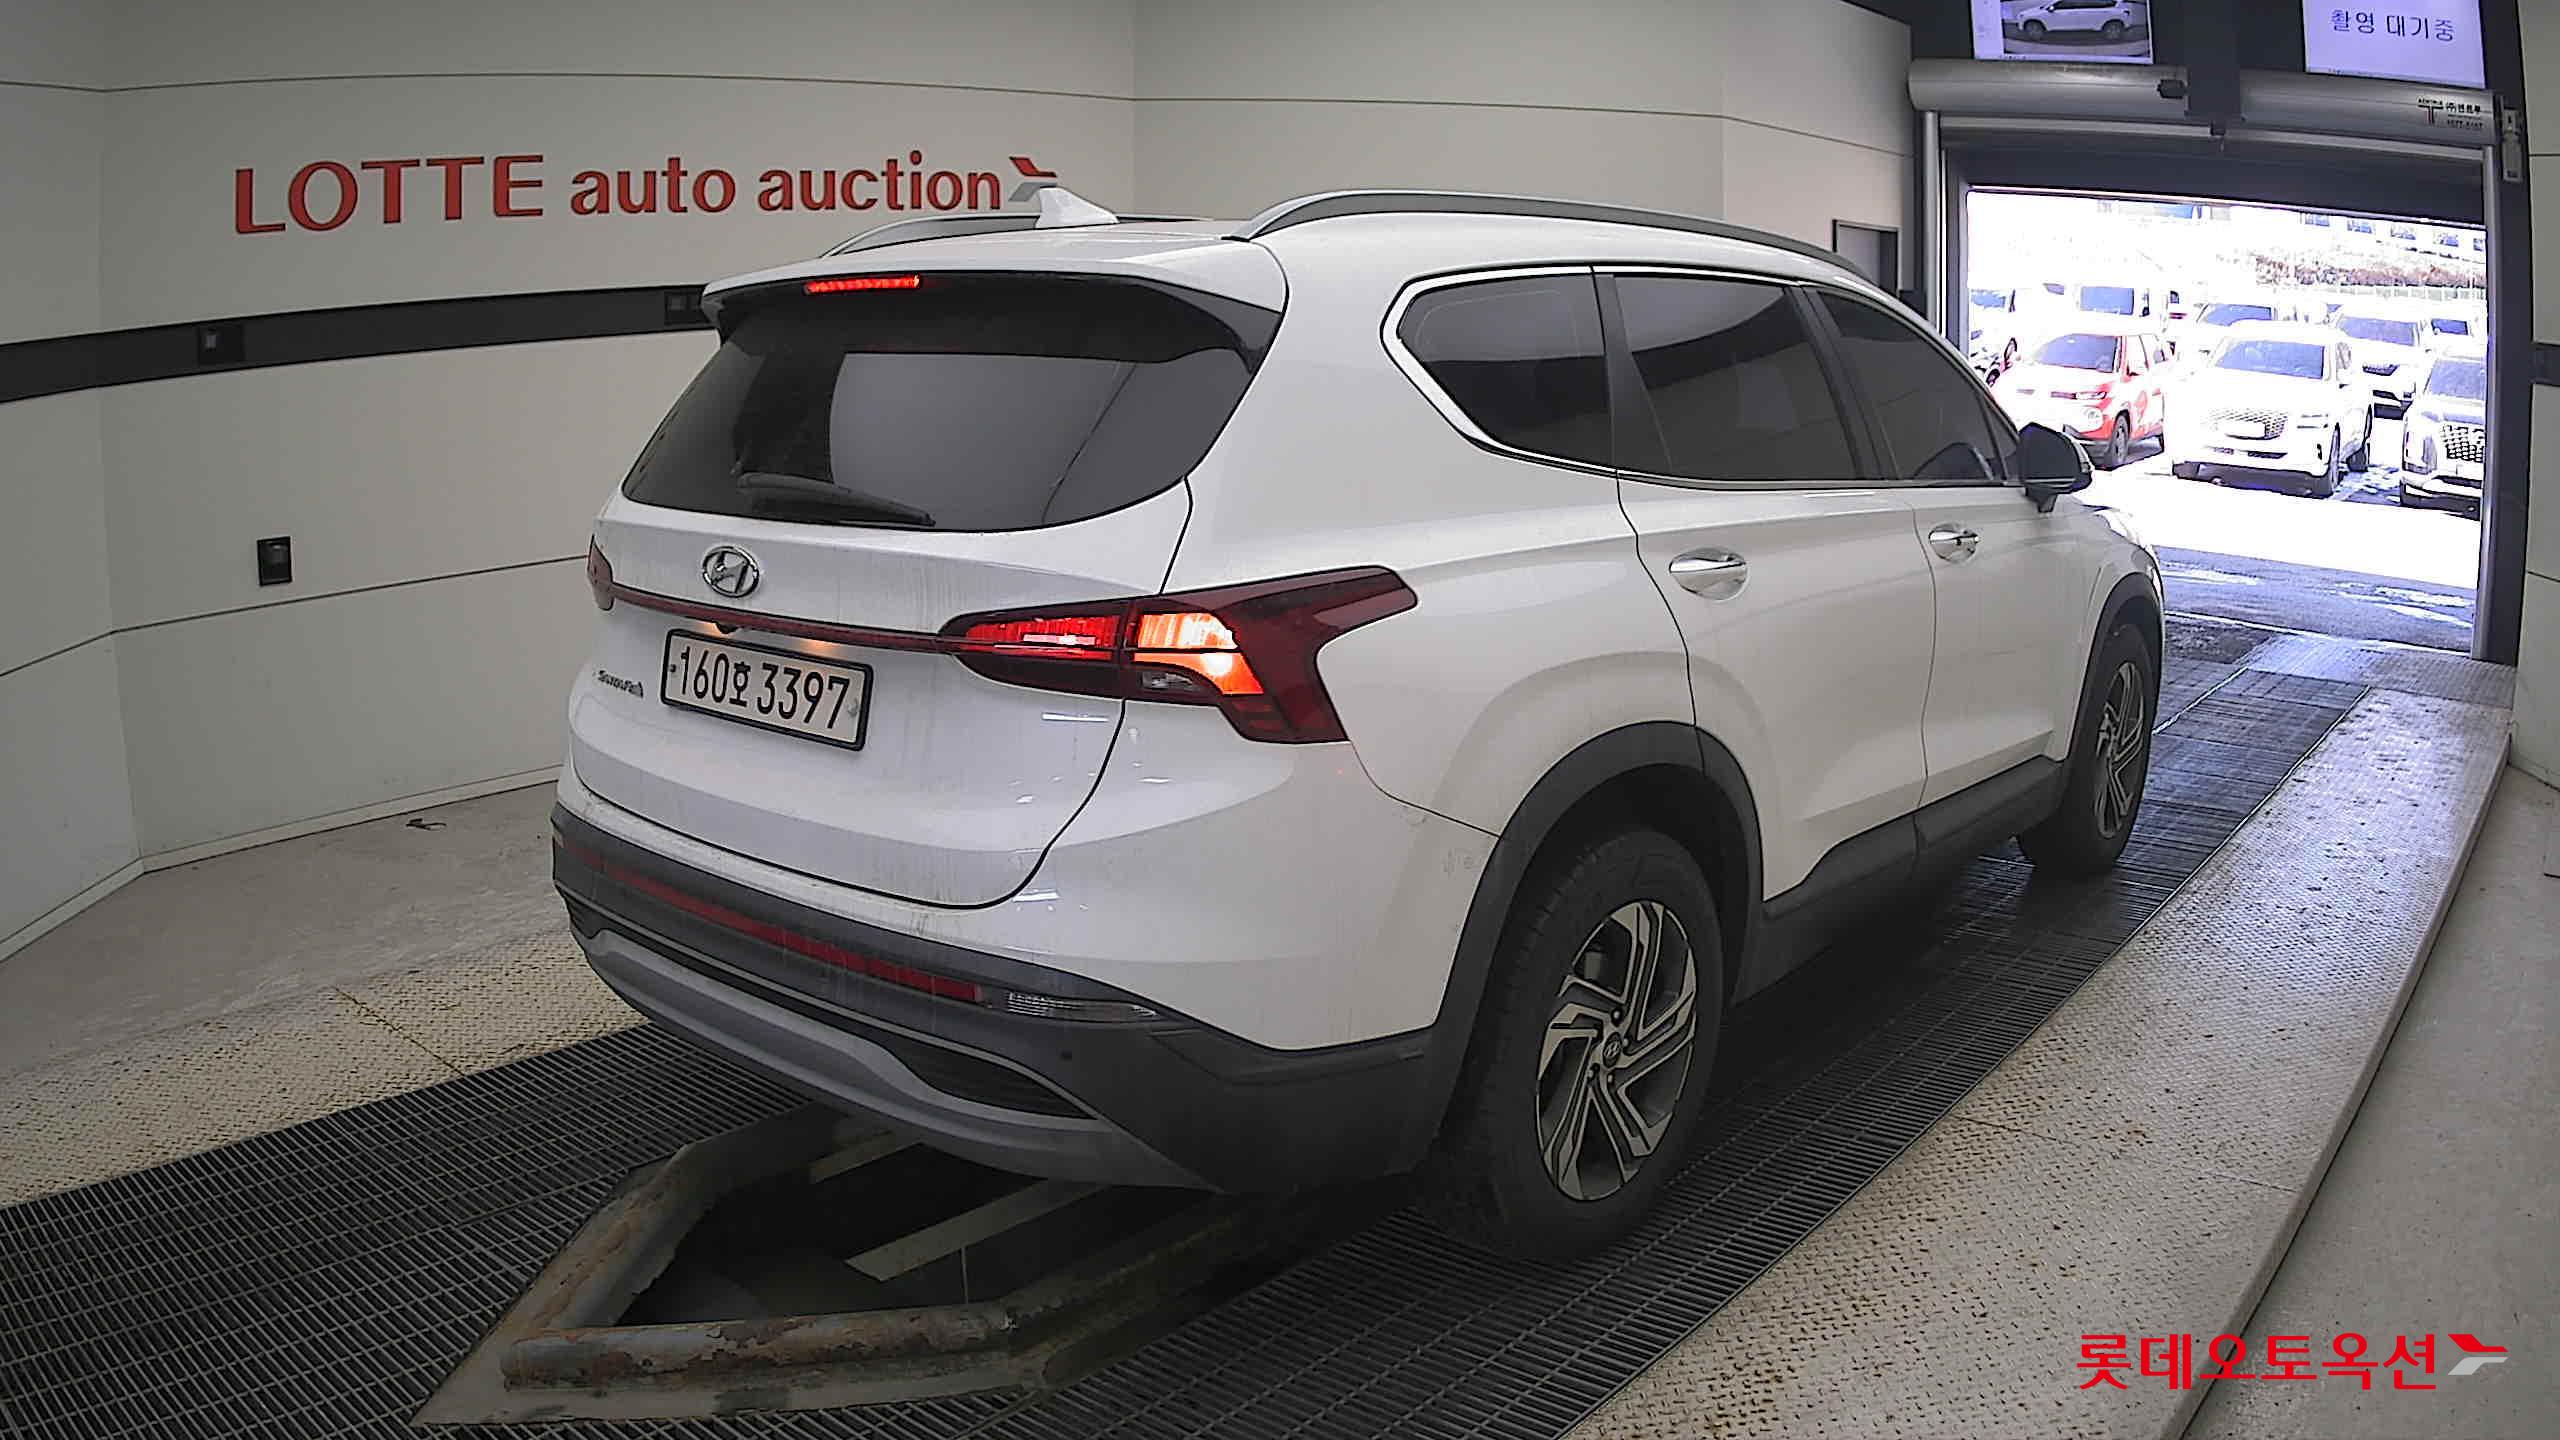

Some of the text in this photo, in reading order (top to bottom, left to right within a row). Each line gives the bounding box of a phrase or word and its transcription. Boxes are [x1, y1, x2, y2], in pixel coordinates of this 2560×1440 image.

[2331, 9, 2454, 42] 촬영 대기중
[235, 150, 1001, 234] LOTTE auto auction
